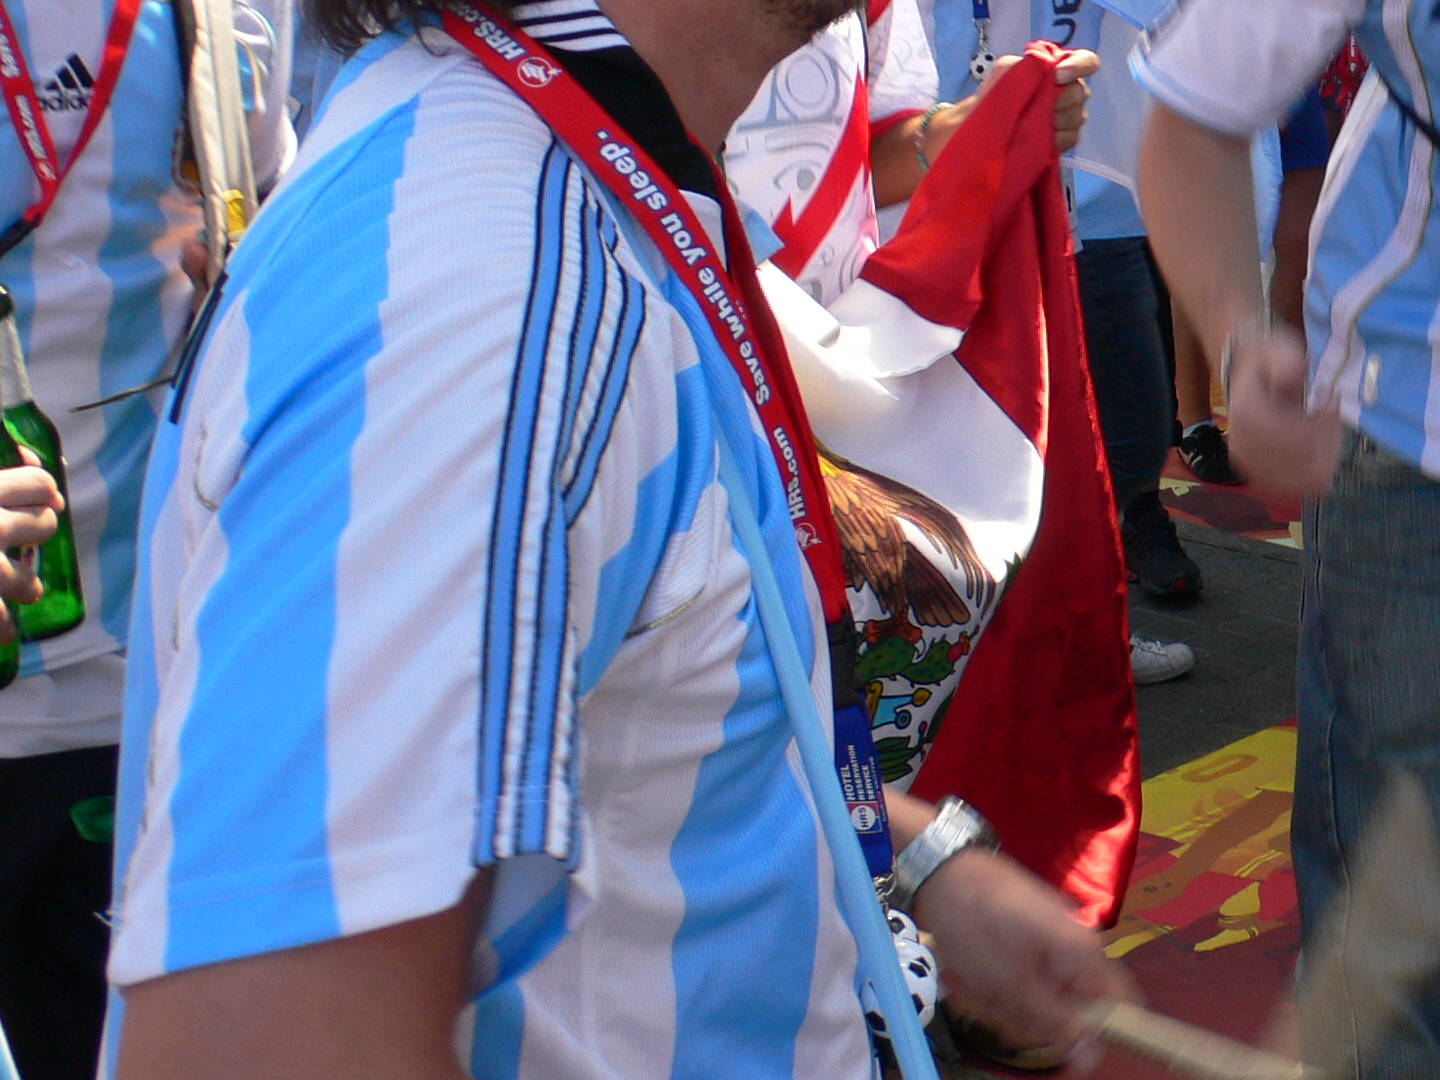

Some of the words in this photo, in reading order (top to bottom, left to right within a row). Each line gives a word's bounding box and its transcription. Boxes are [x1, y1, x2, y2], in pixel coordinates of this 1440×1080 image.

[660, 212, 706, 266] you
[698, 266, 746, 340] while
[739, 339, 770, 406] Save
[773, 426, 806, 520] HRS.com
[841, 764, 856, 800] HOTEL
[847, 744, 866, 801] RESERVATION
